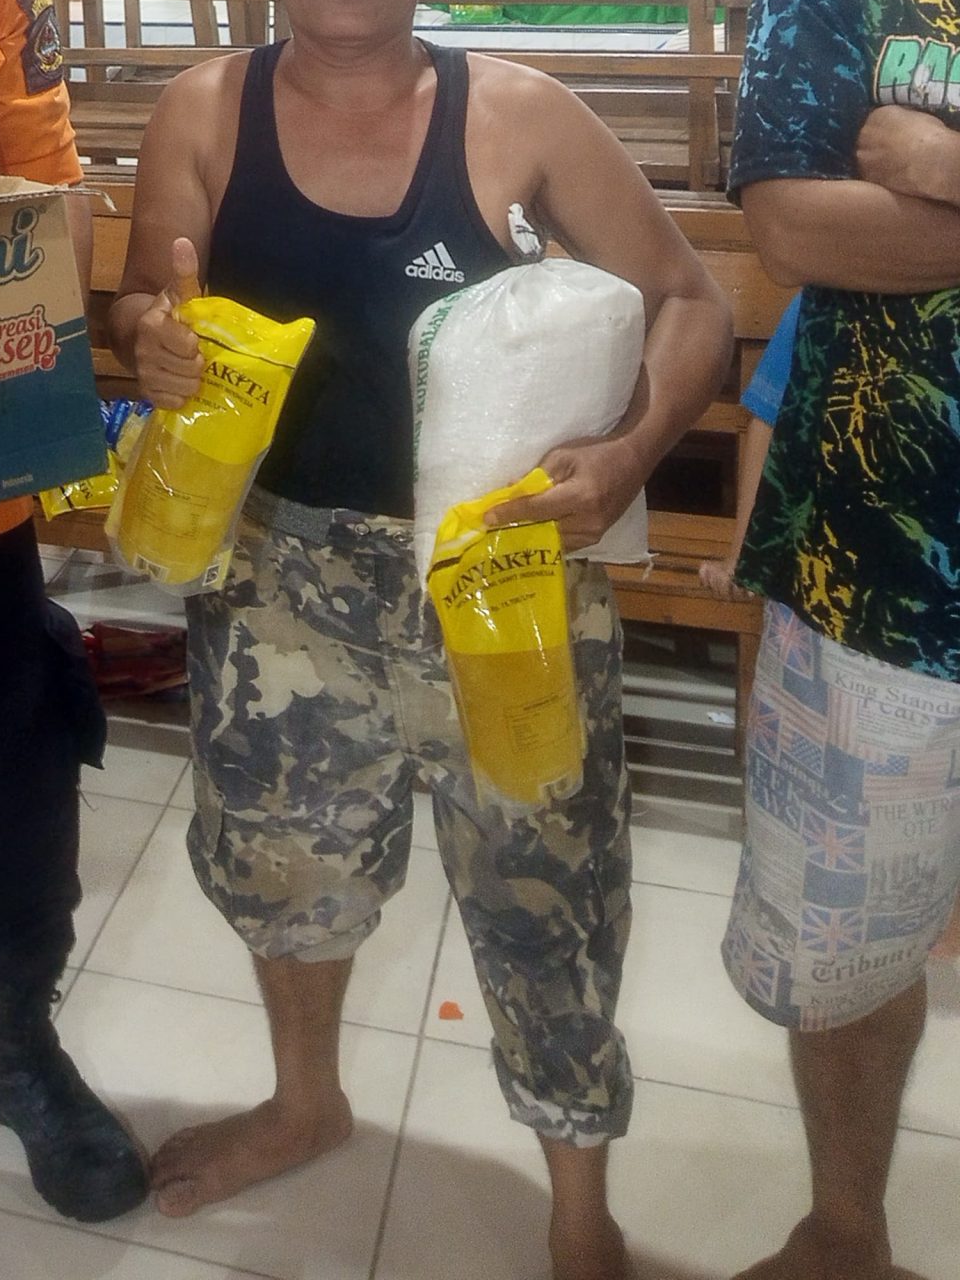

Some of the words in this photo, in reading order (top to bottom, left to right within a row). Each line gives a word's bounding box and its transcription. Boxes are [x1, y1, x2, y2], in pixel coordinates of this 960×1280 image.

[404, 264, 465, 283] adidas
[204, 360, 270, 406] AKITA
[416, 305, 453, 415] KUKUBALAM
